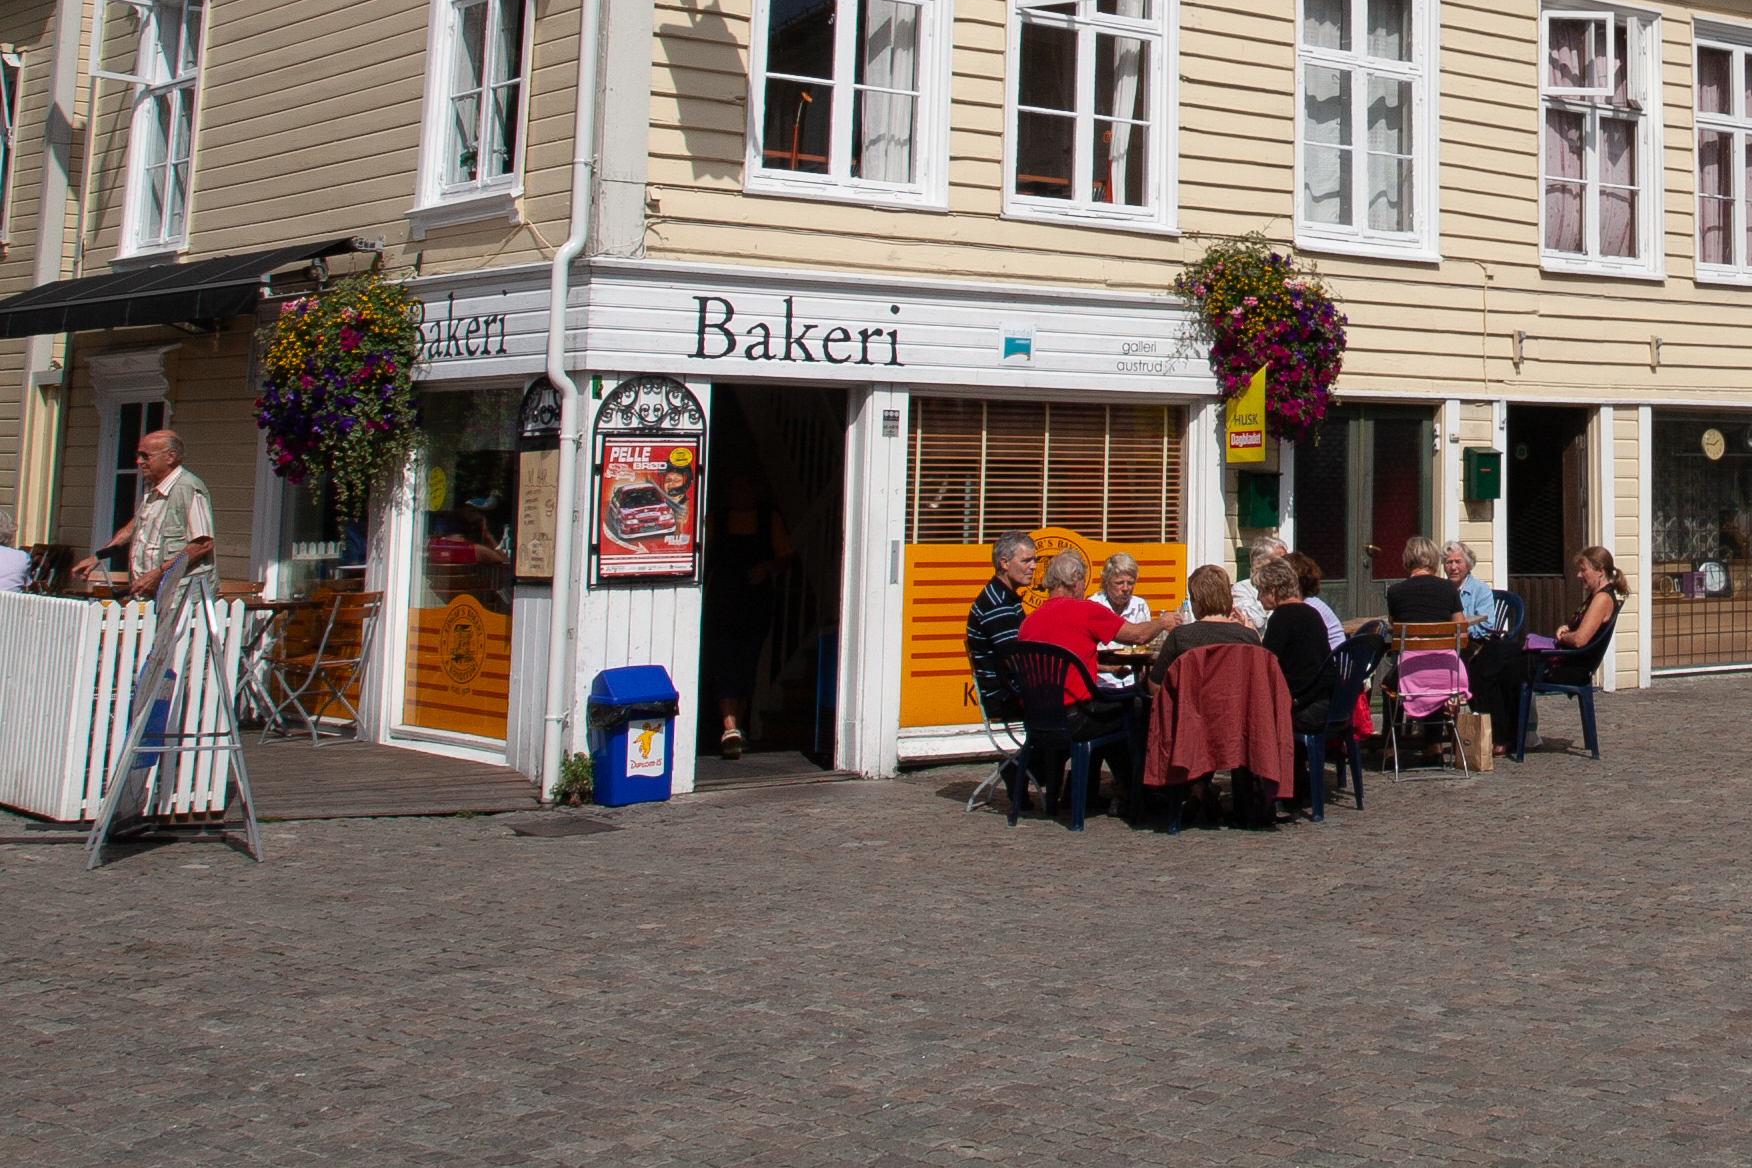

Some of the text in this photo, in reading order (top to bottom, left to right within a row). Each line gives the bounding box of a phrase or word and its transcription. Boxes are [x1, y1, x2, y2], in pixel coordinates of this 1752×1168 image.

[411, 289, 507, 359] Bakeri
[687, 295, 904, 366] Bakeri
[1122, 341, 1157, 355] galleri
[1117, 360, 1163, 373] austrud
[1234, 414, 1258, 426] HUSK
[1231, 433, 1261, 447] Dagbladet
[610, 447, 652, 462] PELLE
